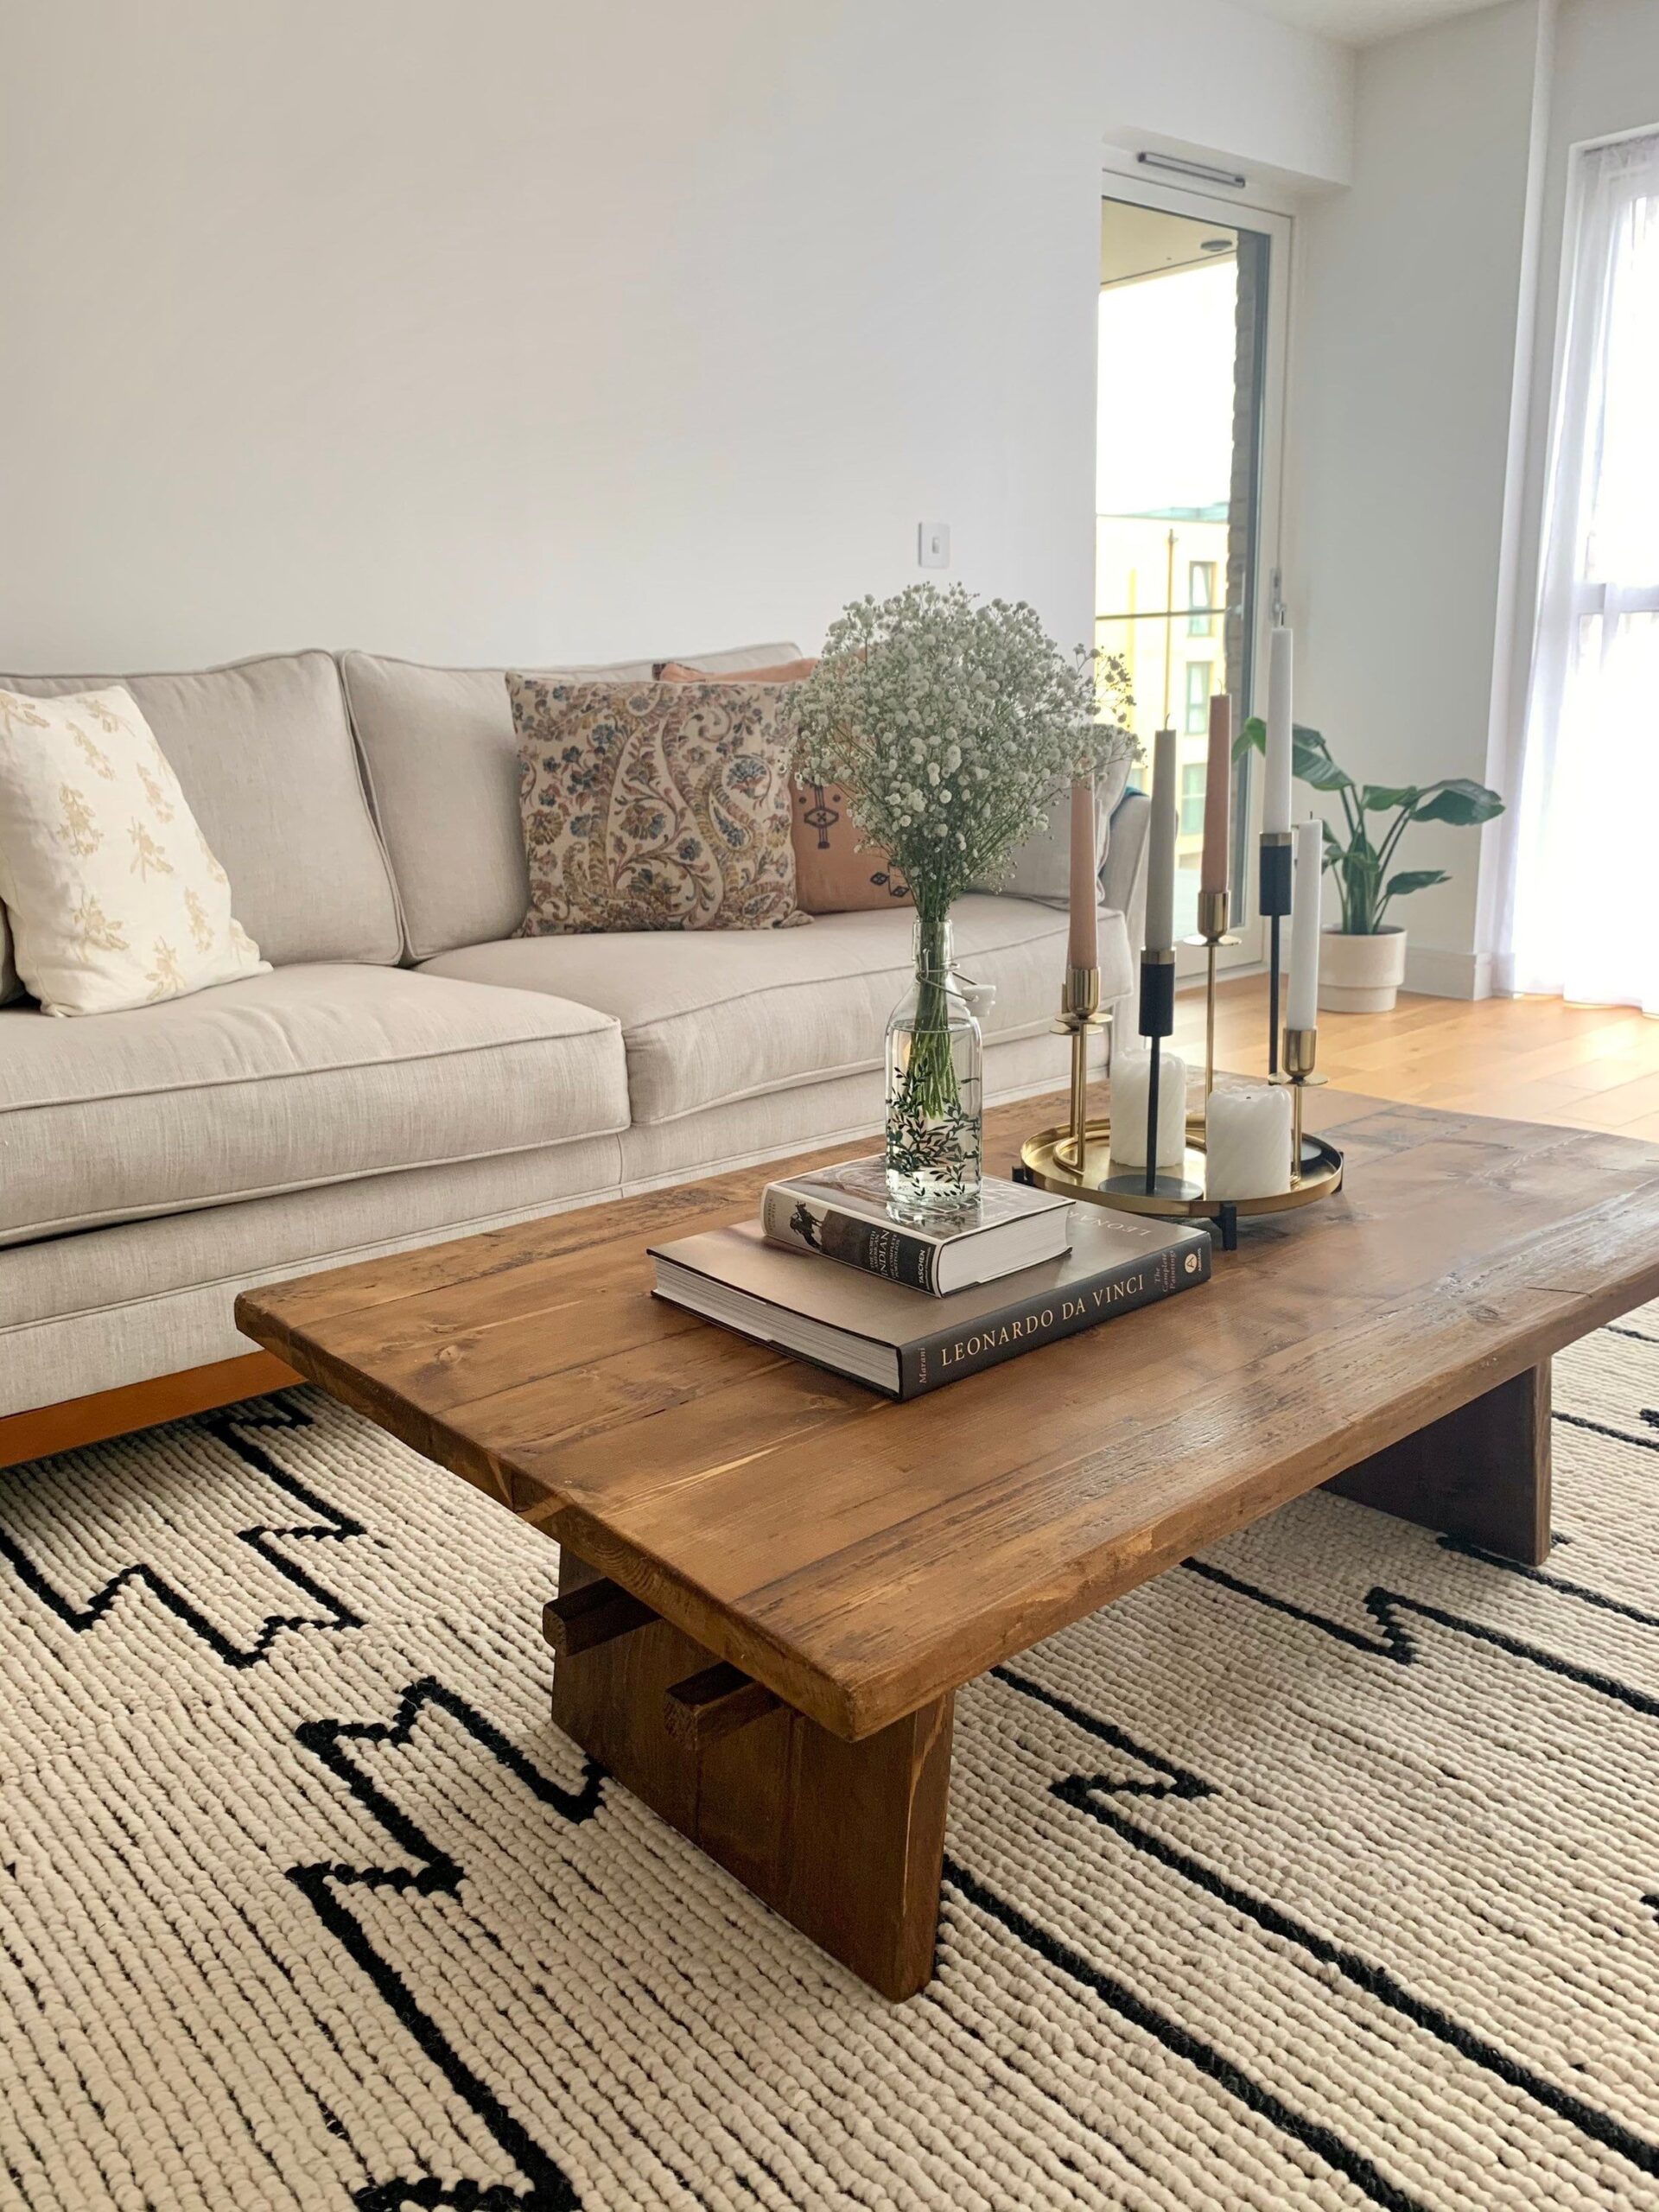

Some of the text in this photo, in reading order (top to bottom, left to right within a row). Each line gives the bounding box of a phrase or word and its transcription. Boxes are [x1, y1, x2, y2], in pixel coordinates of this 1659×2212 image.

[878, 1230, 889, 1276] INDIAN
[1161, 1253, 1170, 1292] Complete
[941, 1274, 1145, 1367] LEONARDO DA VINCI
[918, 1347, 927, 1384] Marani
